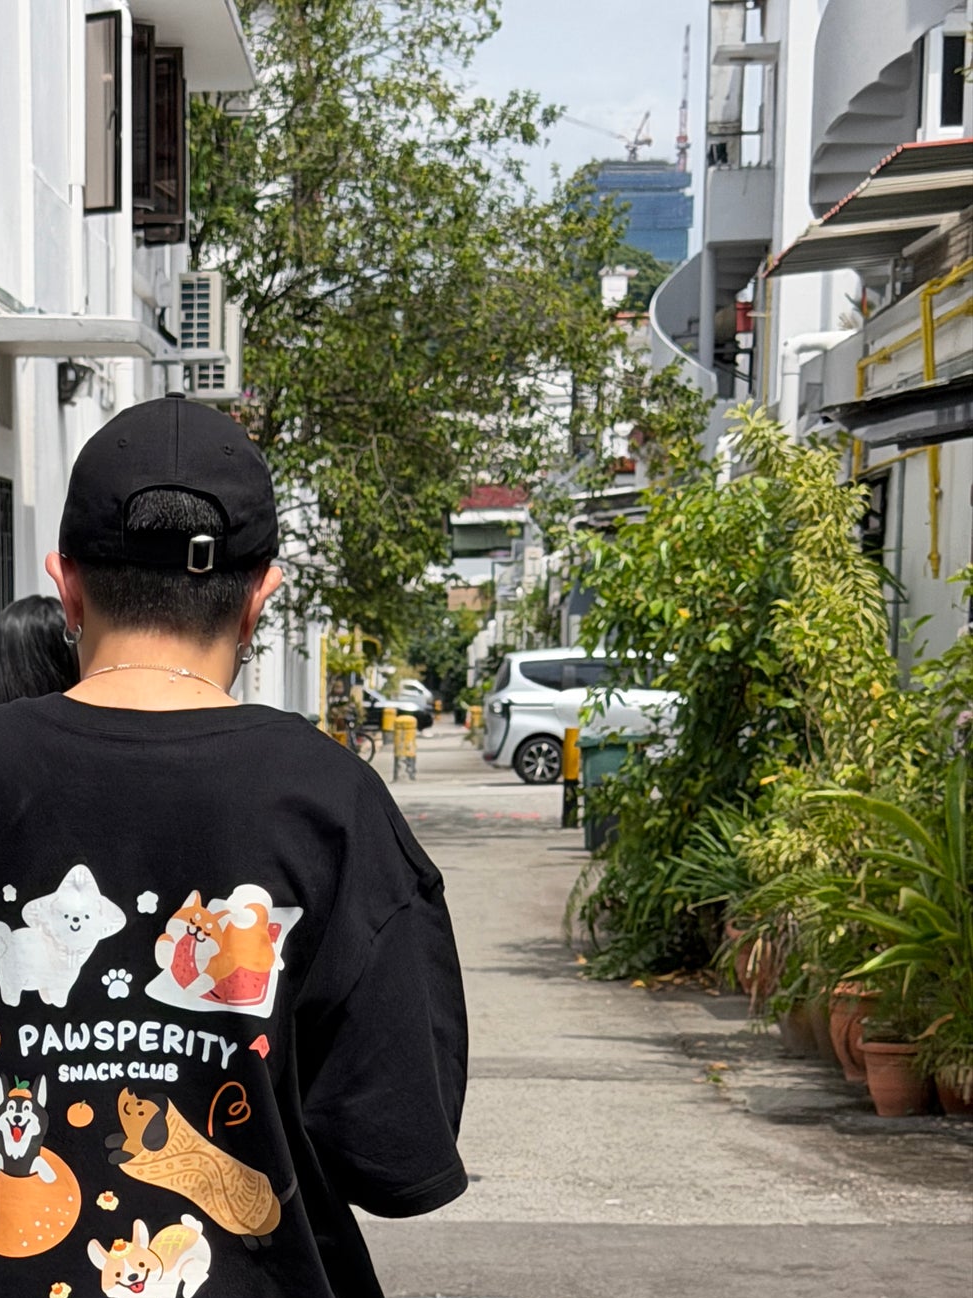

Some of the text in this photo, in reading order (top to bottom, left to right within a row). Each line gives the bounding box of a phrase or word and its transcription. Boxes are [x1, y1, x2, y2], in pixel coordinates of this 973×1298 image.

[18, 1020, 238, 1070] PAWSPERITY
[57, 1061, 179, 1083] SNACK CLUB
